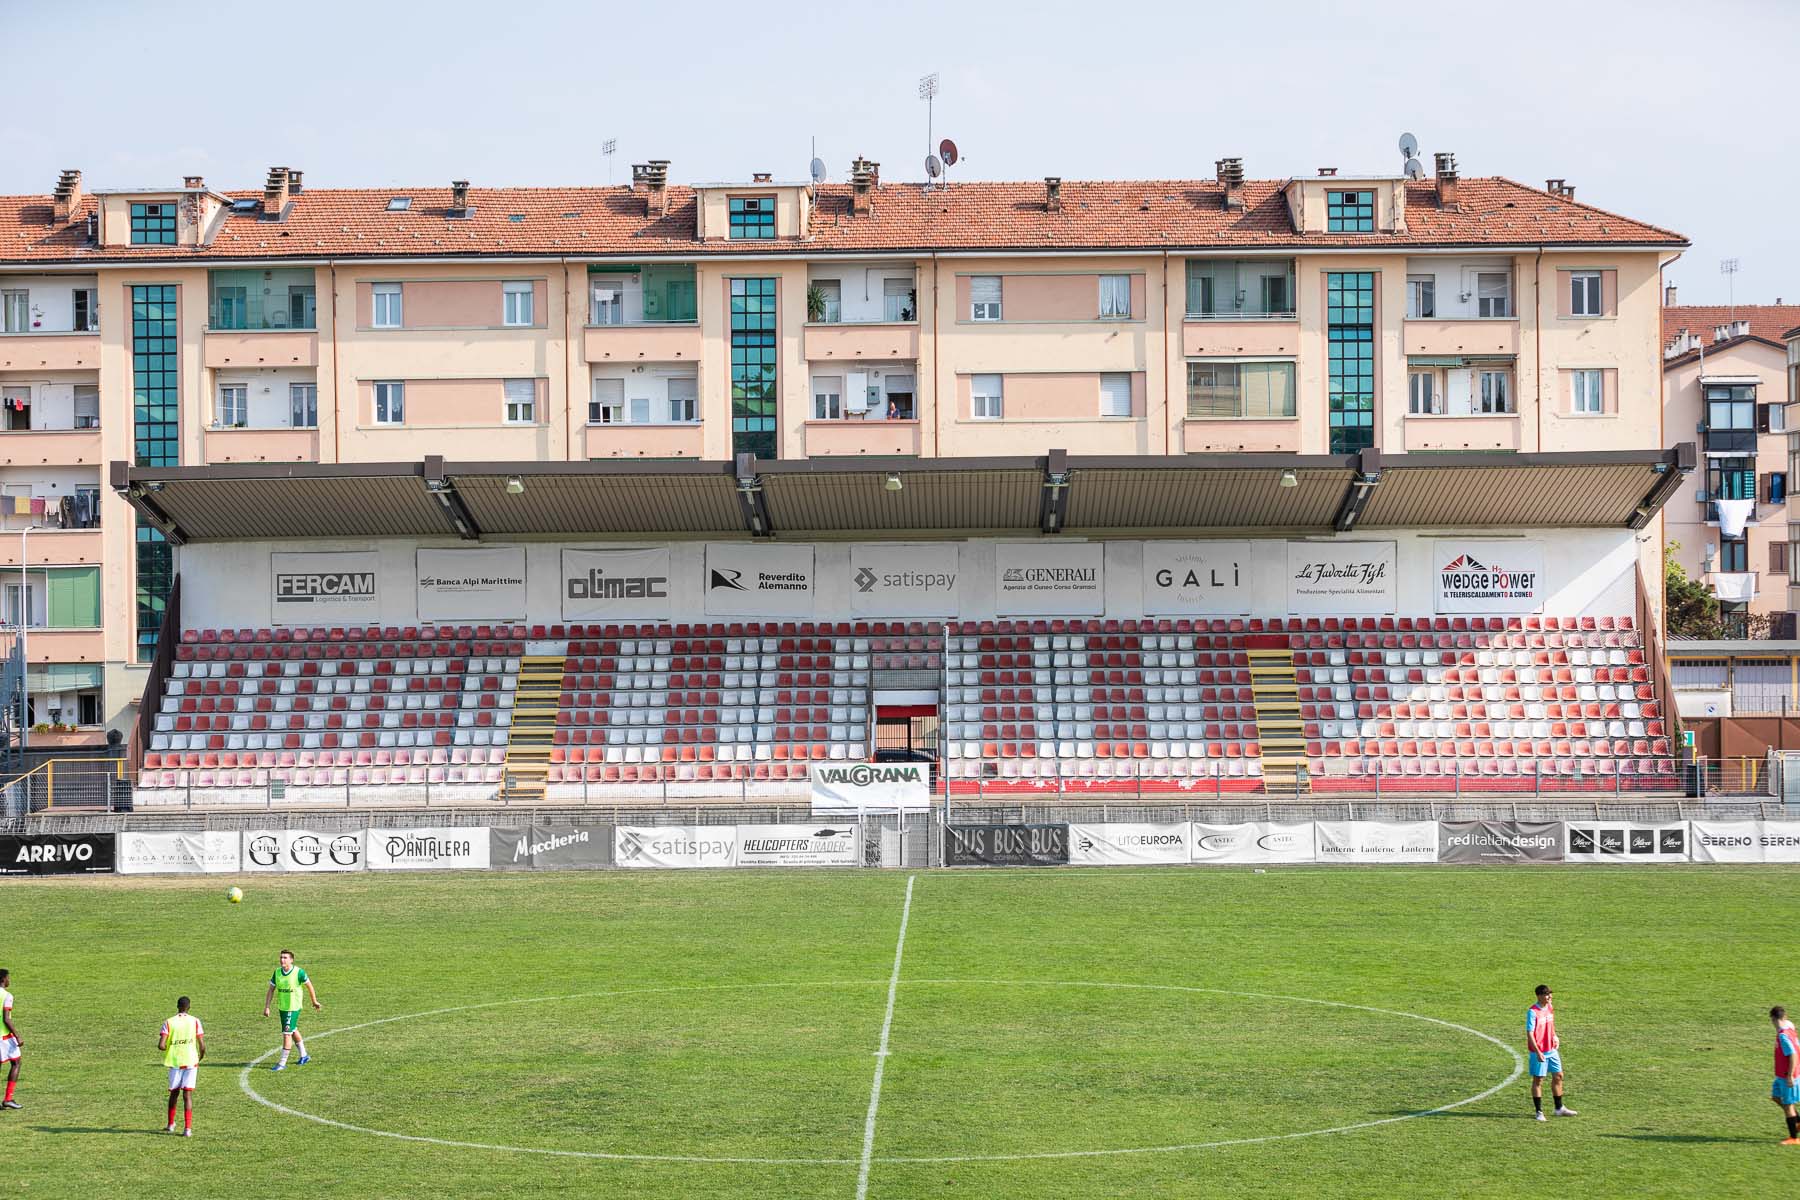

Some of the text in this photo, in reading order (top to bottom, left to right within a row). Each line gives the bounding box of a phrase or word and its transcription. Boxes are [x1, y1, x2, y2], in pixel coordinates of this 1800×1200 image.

[462, 578, 480, 586] Alpi
[481, 577, 522, 585] Marittime
[758, 572, 806, 581] Reverdito
[883, 571, 956, 591] satispay
[1025, 568, 1096, 581] GENERALI
[1295, 563, 1313, 579] La
[1313, 563, 1359, 584] Favorita
[278, 574, 373, 594] FERCAM
[758, 581, 807, 590] Alemanno
[819, 766, 922, 785] VALGRANA
[386, 836, 470, 863] PANTALERA
[651, 837, 734, 860] satispay
[744, 840, 809, 850] HELICOPTERS
[954, 829, 985, 854] BUS
[993, 828, 1025, 854] BUS
[1031, 828, 1062, 854] BUS
[1702, 836, 1752, 846] SERENO
